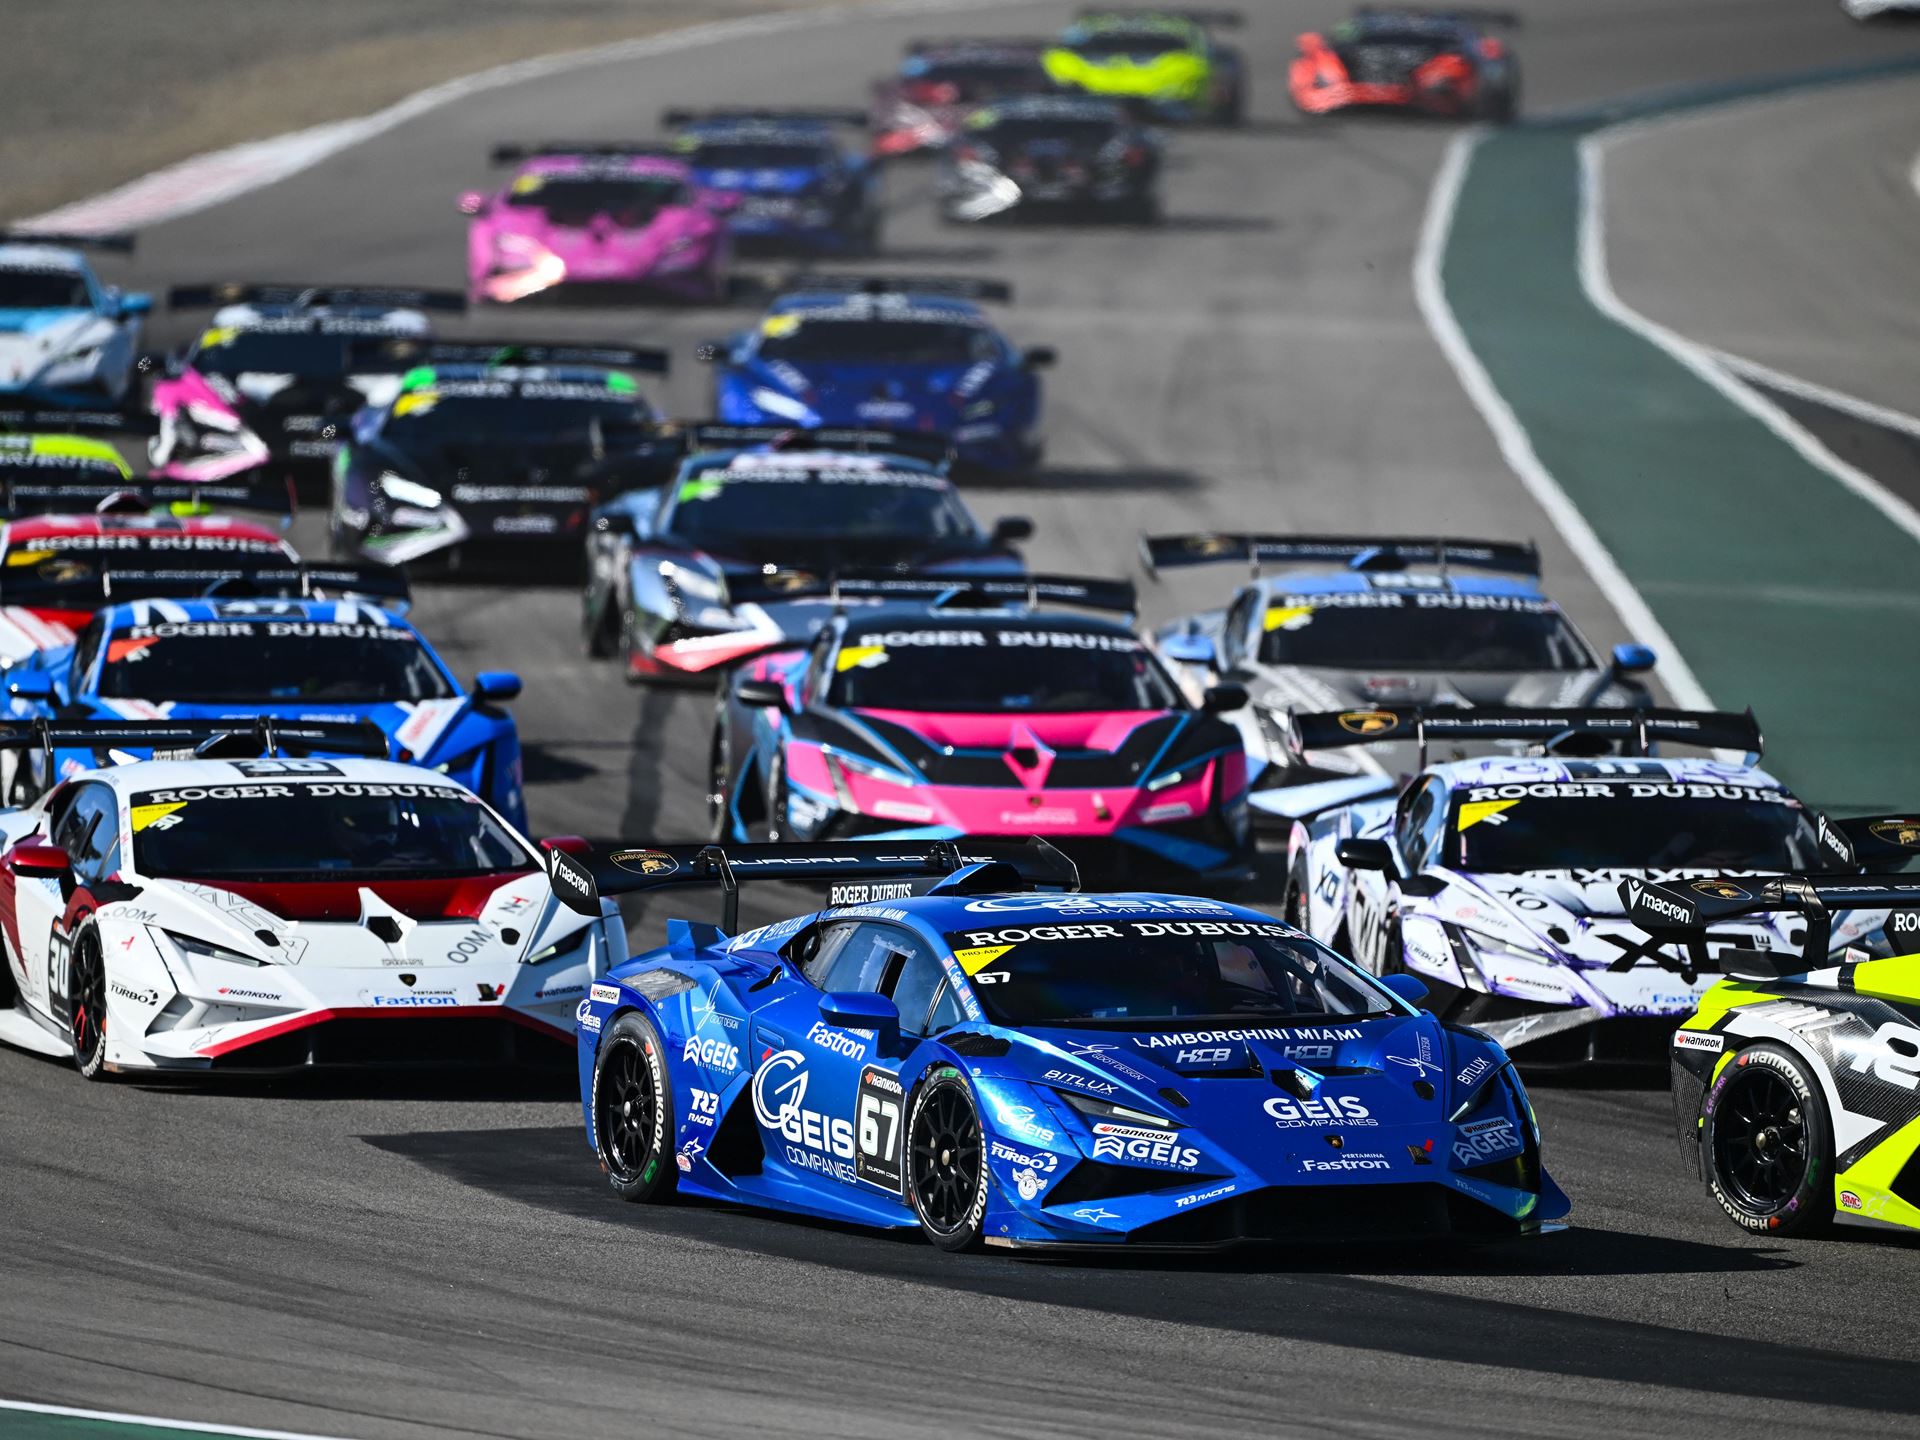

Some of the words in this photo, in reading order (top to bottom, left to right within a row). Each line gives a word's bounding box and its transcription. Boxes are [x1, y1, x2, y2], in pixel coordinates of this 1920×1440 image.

[130, 622, 253, 639] ROGER
[268, 622, 404, 640] DUBUIS
[860, 630, 987, 648] ROGER
[997, 630, 1142, 651] DUBUIS
[151, 785, 295, 804] ROGER
[306, 784, 459, 800] DUBUIS
[1469, 784, 1612, 802] ROGER
[1627, 783, 1784, 803] DUBUIS
[149, 813, 184, 831] 30
[614, 853, 670, 862] LAMBORGHINI
[558, 861, 589, 897] macron
[831, 885, 869, 905] ROGER
[871, 883, 912, 902] DUBUIS
[831, 906, 888, 919] LAMBORGHINI
[886, 910, 909, 922] MIAMI
[1058, 907, 1234, 916] COMPANIES
[1641, 891, 1690, 924] macron
[965, 922, 1124, 946] ROGER
[1131, 920, 1293, 939] DUBUIS
[961, 949, 1000, 957] PRO-AM
[48, 936, 71, 1000] 30
[974, 971, 1011, 984] 67
[110, 984, 149, 1003] TURBO
[374, 995, 458, 1007] Fastron
[582, 1012, 601, 1028] GEIS
[806, 1021, 866, 1061] Fastron
[1133, 1028, 1290, 1048] LAMBORGHINI
[1294, 1028, 1363, 1041] MIAMI
[700, 1039, 739, 1071] GEIS
[698, 1060, 736, 1078] DEVELOPMENT
[1457, 1056, 1491, 1085] BITLUX
[1044, 1069, 1120, 1094] BITLUX
[1263, 1095, 1370, 1120] GEIS
[780, 1103, 854, 1160] GEIS
[859, 1093, 900, 1161] 67
[1275, 1118, 1379, 1128] COMPANIES
[1470, 1127, 1521, 1155] GEIS
[991, 1145, 1045, 1169] TURBO
[1124, 1155, 1196, 1172] DEVELOPMENT
[1127, 1139, 1201, 1168] GEIS
[786, 1144, 857, 1184] COMPANIES
[1302, 1158, 1391, 1172] Fastron
[1841, 1191, 1862, 1206] BMC
